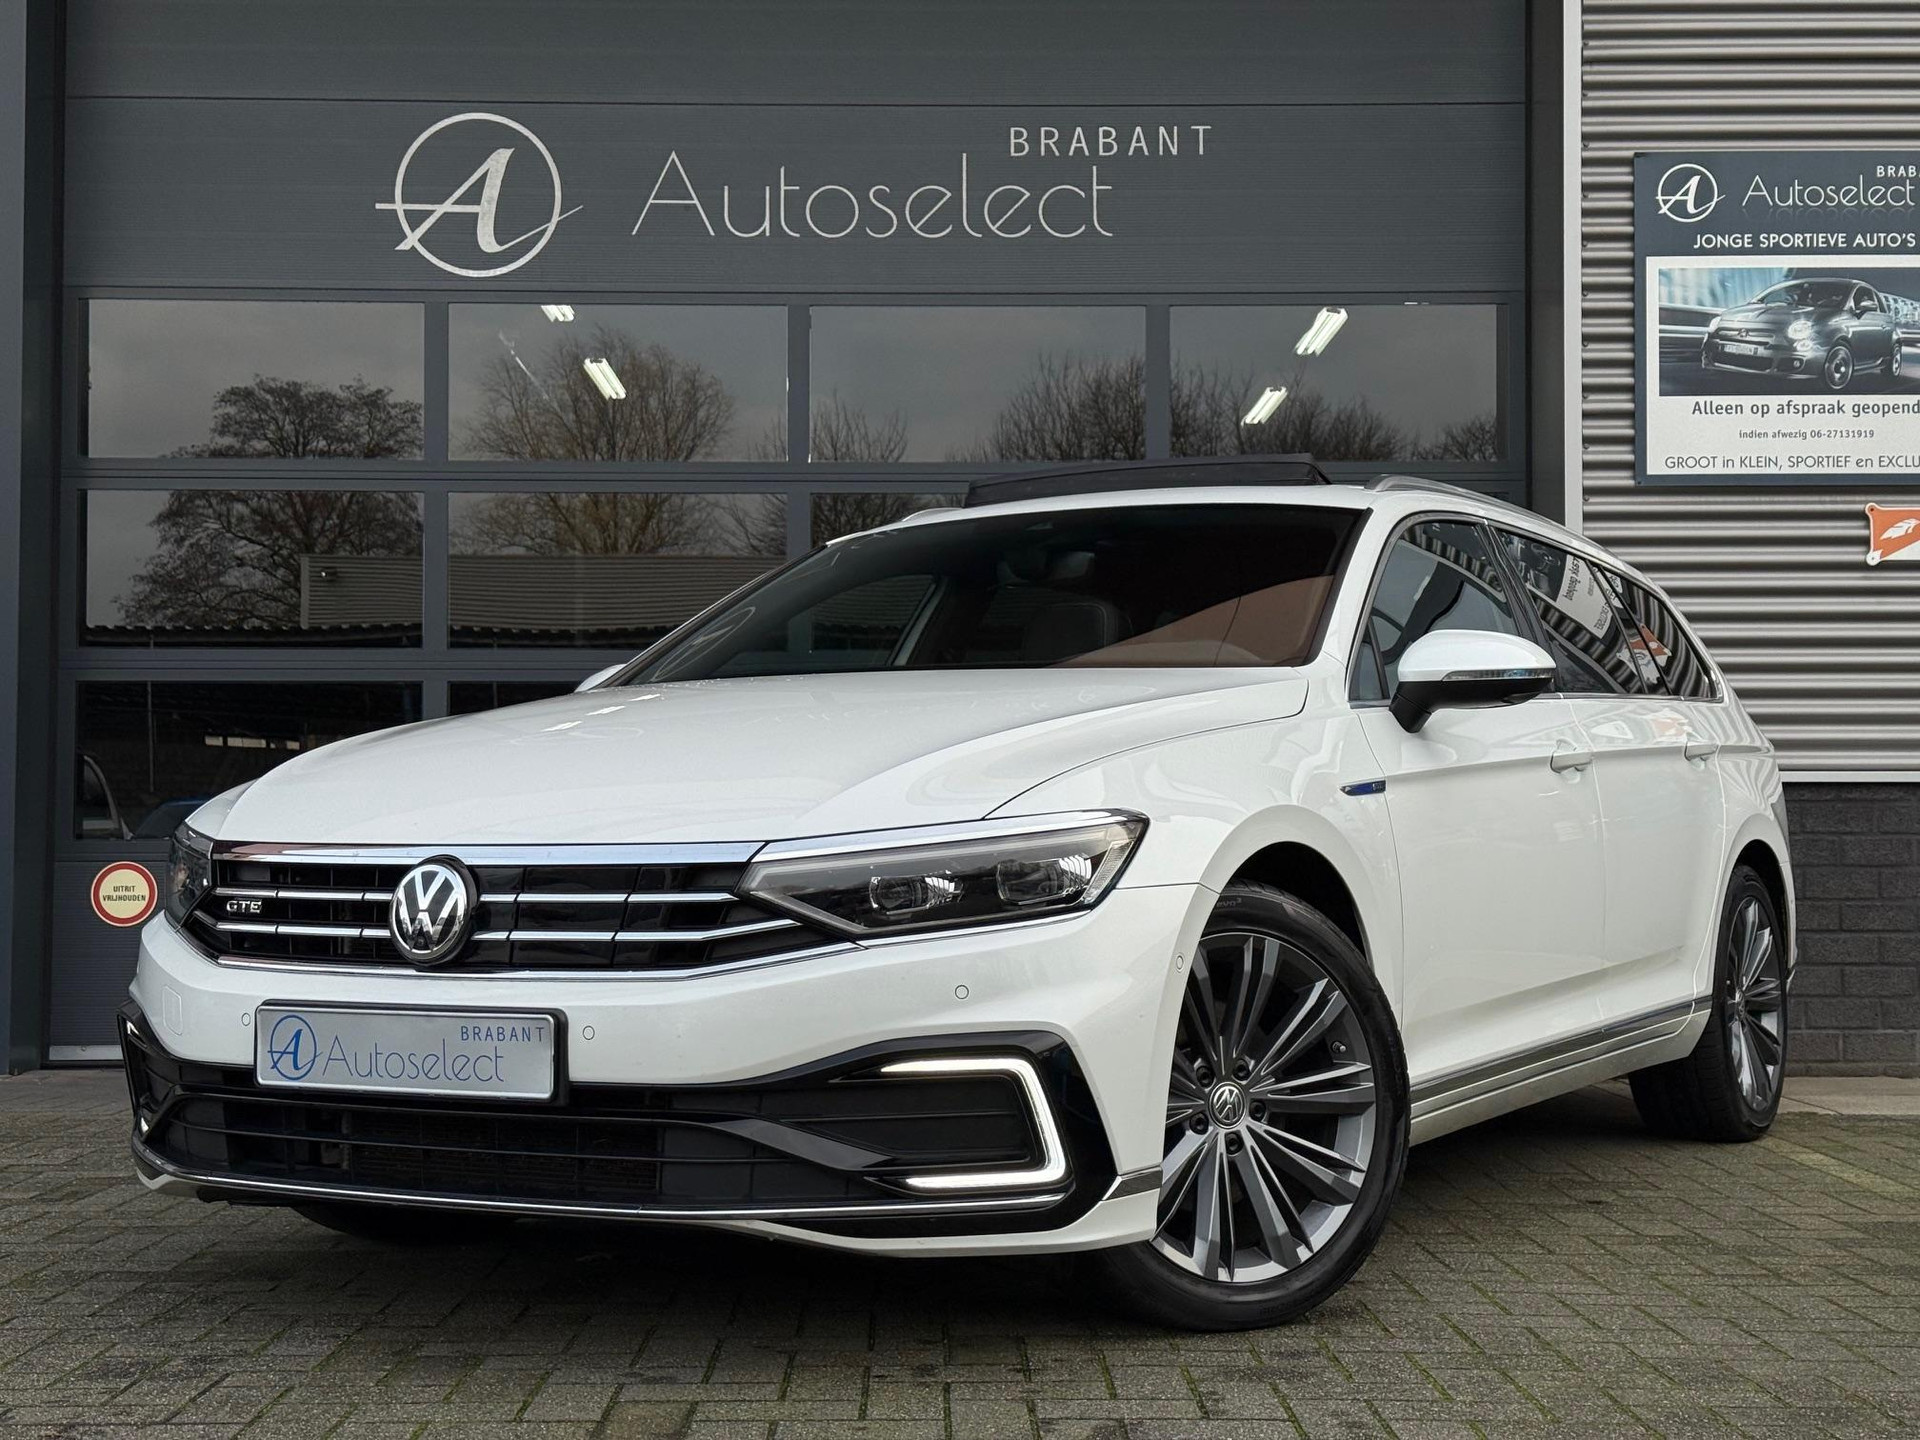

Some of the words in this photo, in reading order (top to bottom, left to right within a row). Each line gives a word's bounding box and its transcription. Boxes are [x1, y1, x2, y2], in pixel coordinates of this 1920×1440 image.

[1009, 125, 1212, 158] BRABANT
[1876, 165, 1920, 178] BRAB
[632, 151, 1114, 238] Autoselect
[1742, 174, 1915, 207] Autoselect
[1693, 233, 1753, 249] JONGE
[1759, 233, 1847, 248] SPORTIEVE
[1852, 232, 1916, 248] AUTO'S
[1692, 400, 1744, 415] Alleen
[1750, 403, 1771, 418] op
[1776, 399, 1846, 418] afspraak
[1851, 399, 1920, 418] geopend
[1738, 429, 1769, 439] indien
[1771, 429, 1807, 441] afwezig
[1809, 429, 1875, 439] 06-27131919
[1664, 456, 1718, 469] GROOT
[1722, 456, 1735, 469] in
[1739, 455, 1783, 471] KLEIN,
[1787, 455, 1852, 468] SPORTIEF
[1855, 457, 1874, 468] en
[113, 885, 136, 893] UITRIT
[102, 894, 146, 902] VRIJHOUDEN
[226, 900, 262, 914] GTE
[460, 1026, 546, 1043] BRABANT
[322, 1035, 505, 1083] Autoselect
